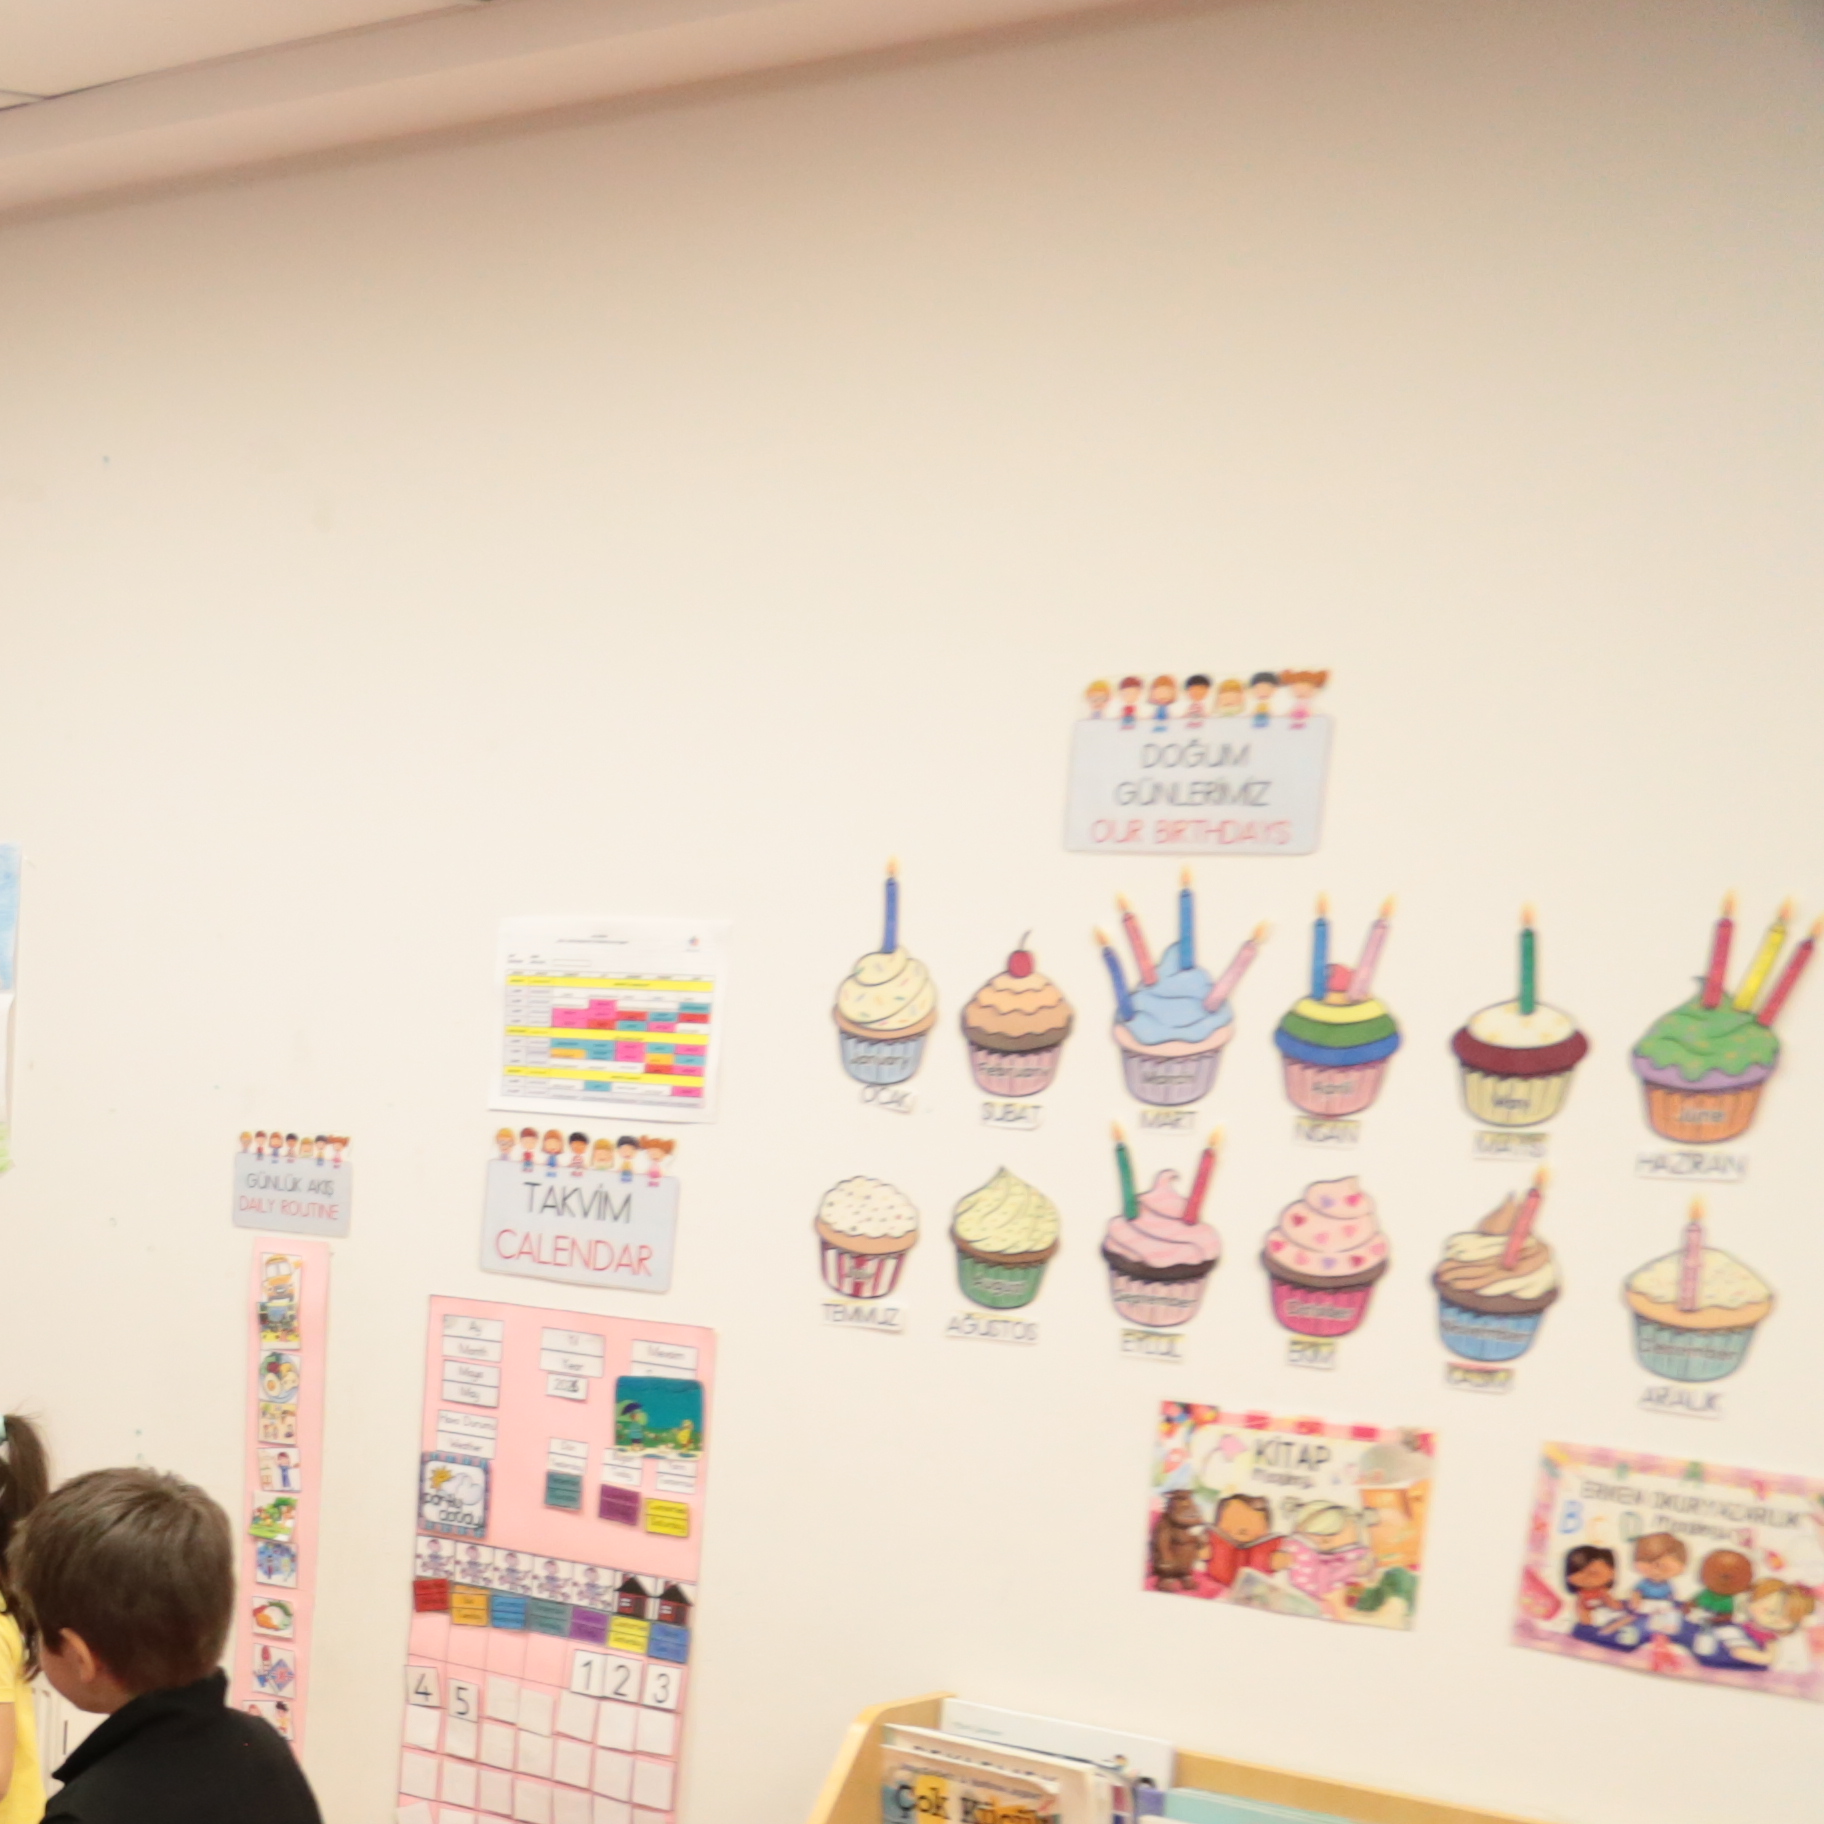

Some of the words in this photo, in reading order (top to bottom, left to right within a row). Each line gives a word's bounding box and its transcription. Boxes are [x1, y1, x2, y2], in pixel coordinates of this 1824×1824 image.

[1141, 738, 1252, 768] DOĞUM
[1090, 820, 1144, 843] OUR
[1155, 820, 1292, 845] BIRTHDAYS
[239, 1195, 275, 1213] DAILY
[523, 1181, 632, 1224] TAKVİM
[495, 1228, 655, 1276] CALENDAR
[1256, 1436, 1331, 1471] KİTAP
[1558, 1500, 1584, 1534] B
[414, 1674, 433, 1701] 4
[455, 1686, 470, 1715] 5
[581, 1660, 594, 1691] 1
[614, 1665, 630, 1696] 2
[653, 1674, 670, 1703] 3
[896, 1784, 950, 1820] Çok
